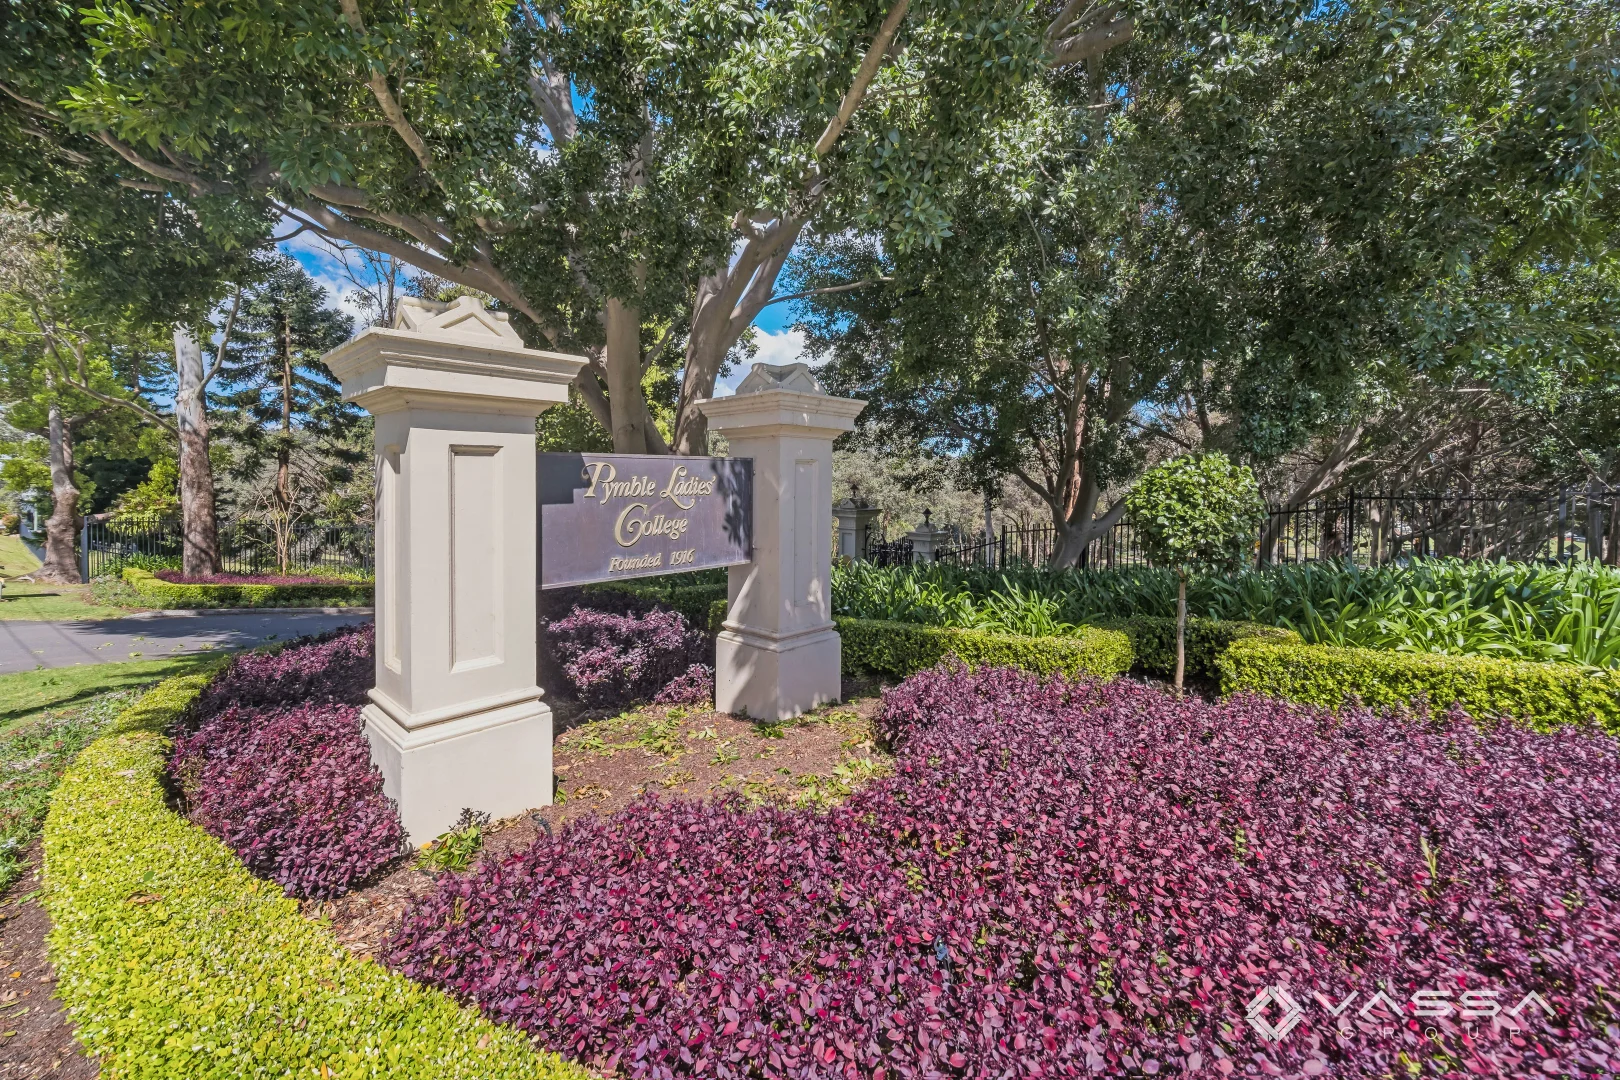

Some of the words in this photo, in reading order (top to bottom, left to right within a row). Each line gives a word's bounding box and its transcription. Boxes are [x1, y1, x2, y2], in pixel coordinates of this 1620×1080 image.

[581, 462, 656, 505] Pymble
[614, 503, 688, 547] College
[608, 553, 661, 572] Founded
[669, 548, 695, 566] 1916
